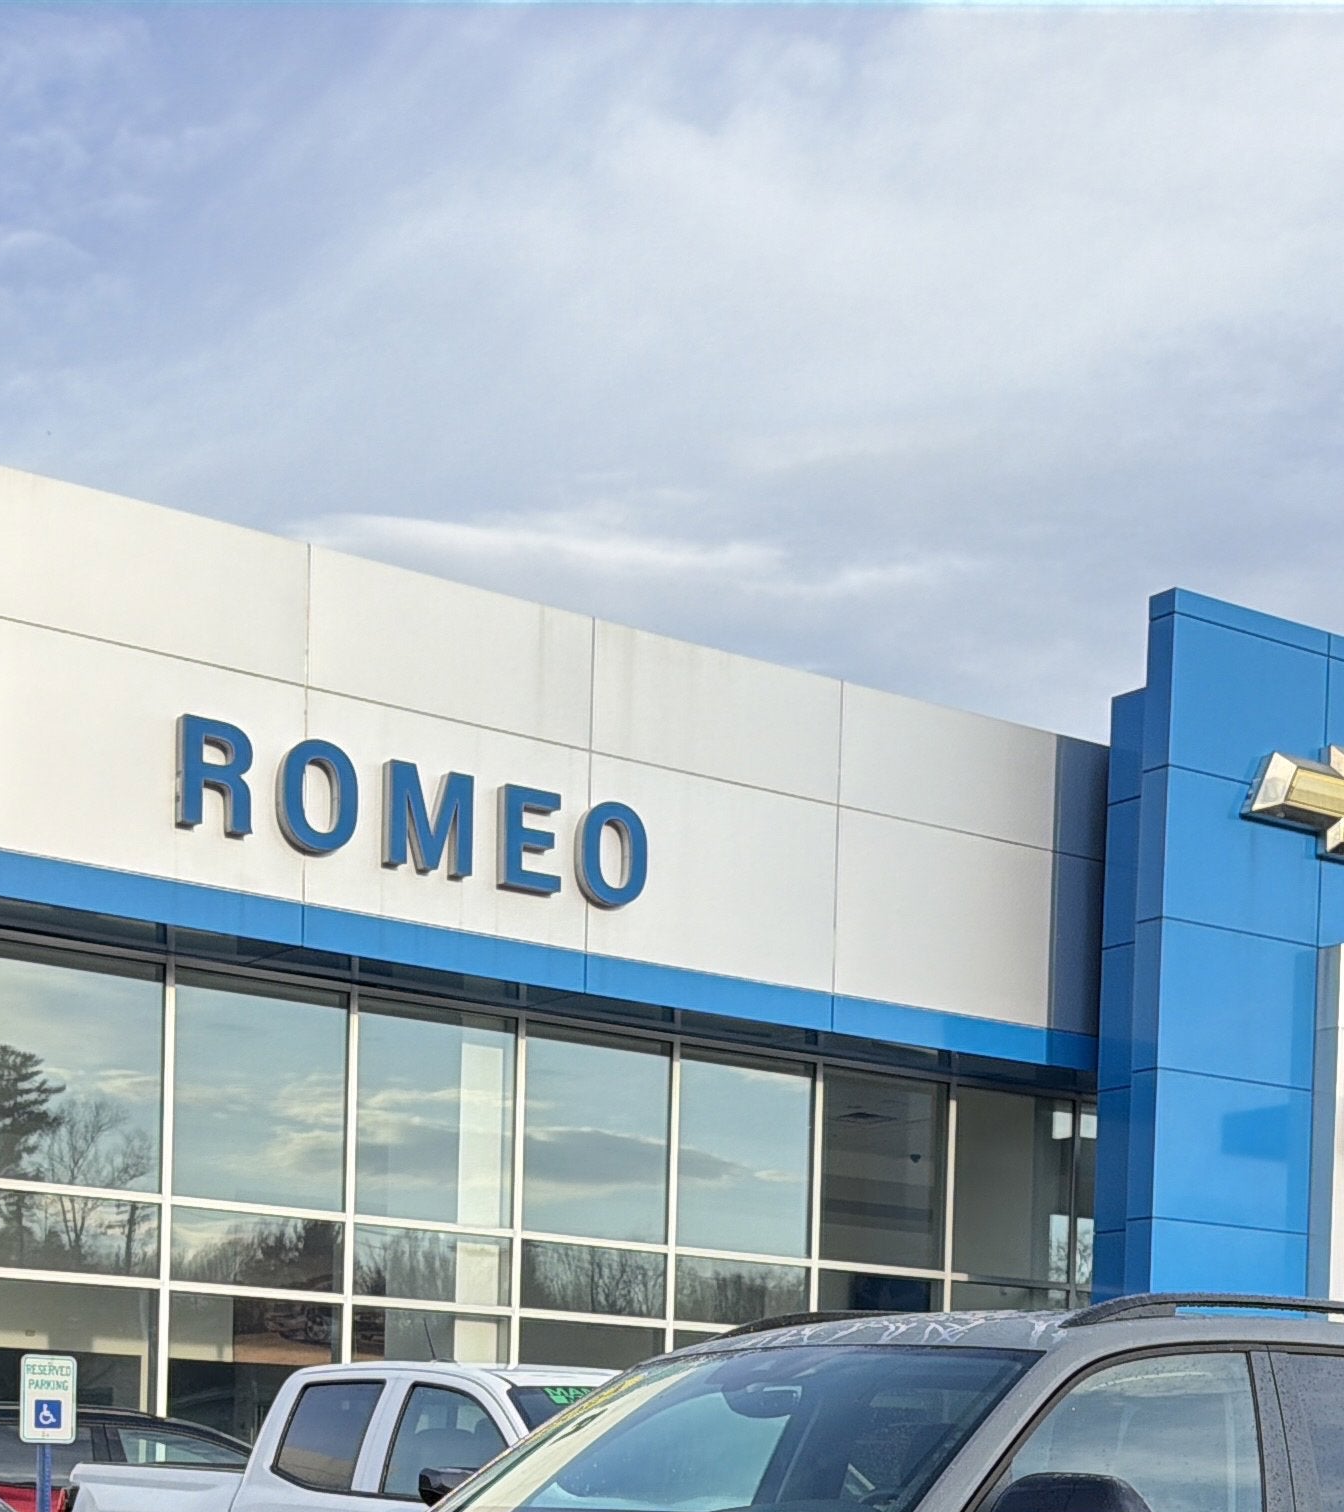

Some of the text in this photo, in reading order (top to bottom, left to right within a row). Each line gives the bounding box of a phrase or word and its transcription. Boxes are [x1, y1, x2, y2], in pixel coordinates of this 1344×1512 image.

[175, 714, 648, 909] ROMEO
[25, 1364, 72, 1377] RESERVED
[28, 1379, 69, 1391] PARKING
